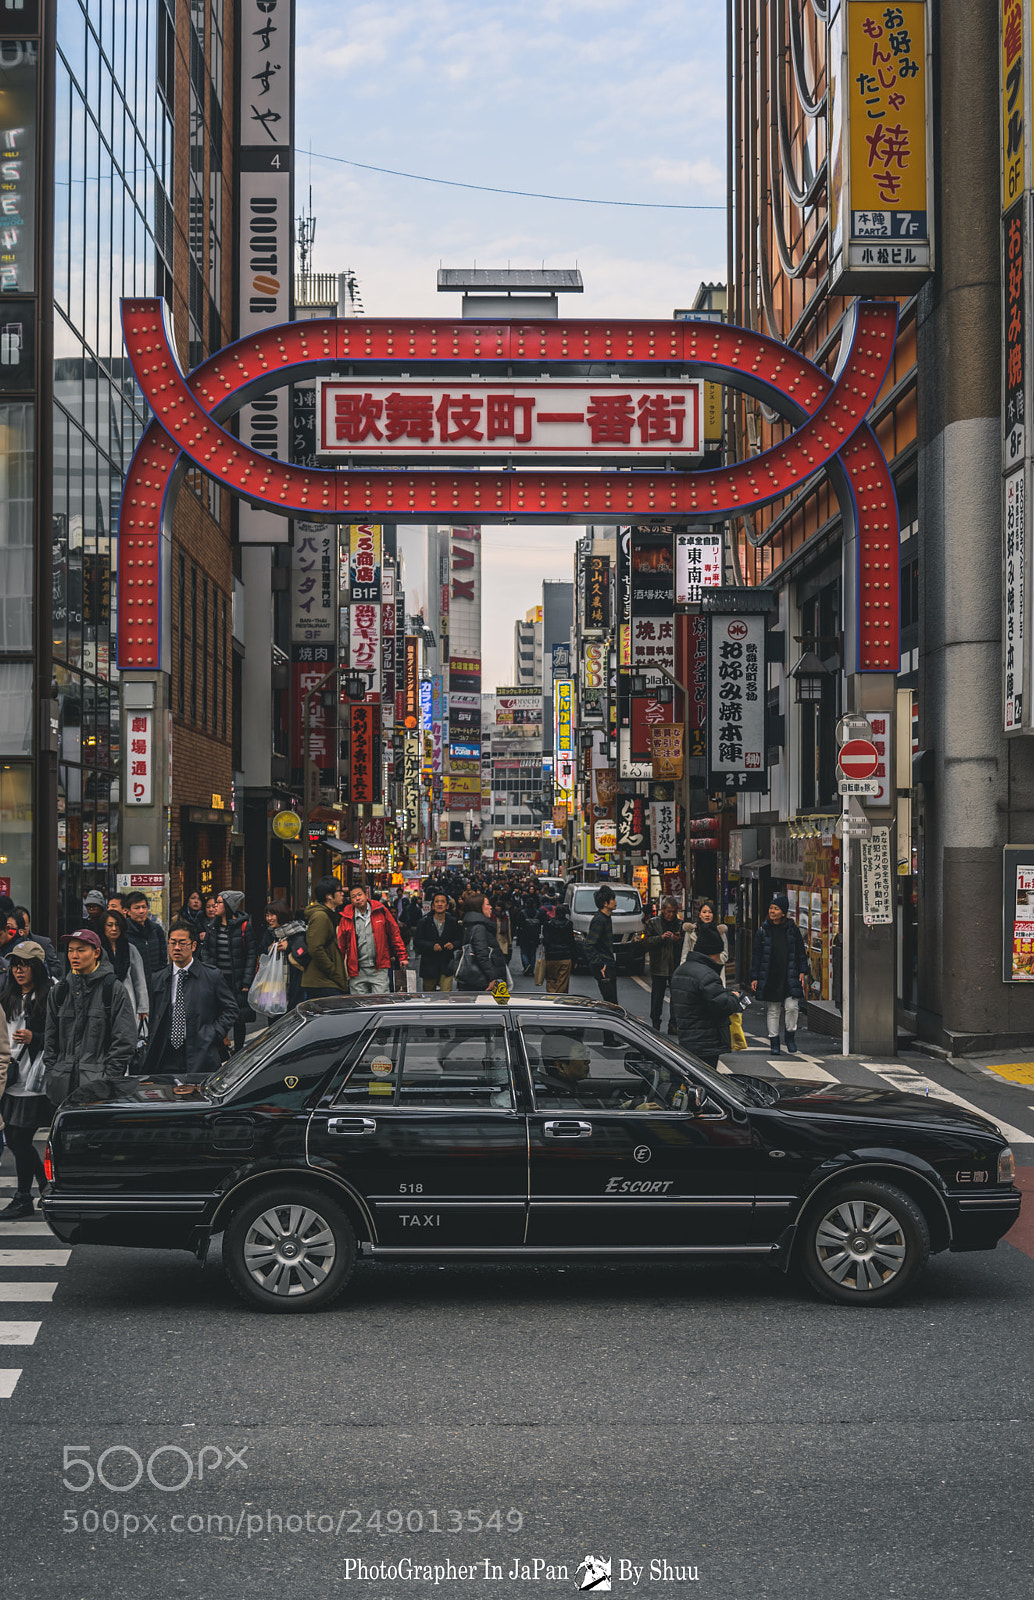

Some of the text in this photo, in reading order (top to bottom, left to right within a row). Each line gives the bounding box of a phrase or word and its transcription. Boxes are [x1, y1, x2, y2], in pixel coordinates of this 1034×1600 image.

[882, 8, 920, 78] お好み
[862, 18, 907, 111] もんじゃ
[250, 17, 282, 142] すずや
[855, 73, 886, 119] たこ
[270, 154, 281, 168] 4
[865, 124, 911, 203] 焼き
[857, 212, 886, 226] 本陣
[896, 213, 920, 235] 7F
[858, 226, 888, 236] PART2
[862, 248, 917, 264] 小松ビル
[335, 392, 686, 444] 歌舞伎町一番街
[1010, 427, 1022, 459] 8F
[678, 536, 720, 546] 全卓全自動
[296, 537, 318, 613] バンタイ
[687, 547, 702, 602] 東南荘
[704, 564, 712, 585] 専門
[352, 588, 378, 599] B1F
[304, 630, 321, 640] 3F
[635, 620, 673, 641] 焼肉
[299, 647, 328, 661] 焼肉
[586, 644, 602, 687] GOD
[718, 641, 743, 763] お好み焼本陣
[131, 717, 147, 797] 劇場通り
[725, 773, 747, 786] 2F
[841, 782, 876, 793] 自転車を除く
[872, 835, 883, 908] 防犯カメラ作動中
[399, 1183, 423, 1194] 518
[399, 1215, 441, 1227] TAXI
